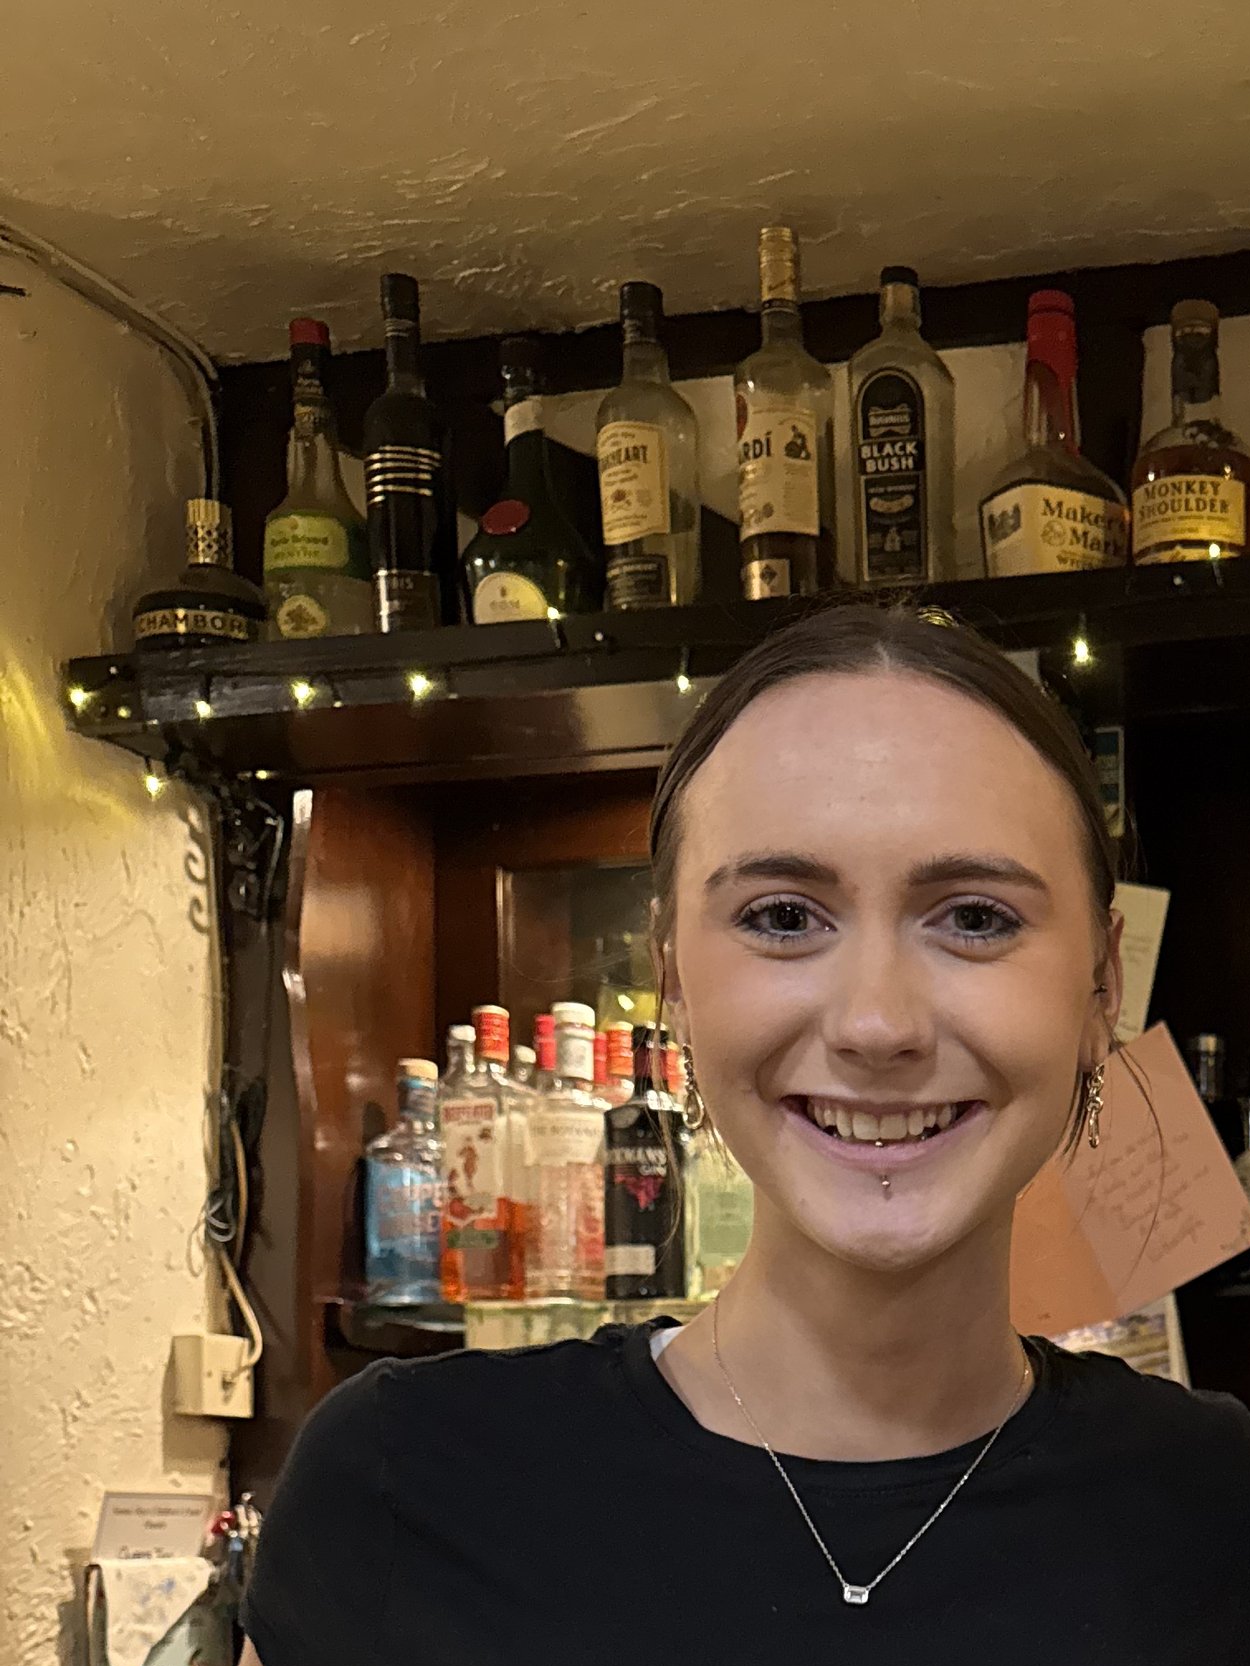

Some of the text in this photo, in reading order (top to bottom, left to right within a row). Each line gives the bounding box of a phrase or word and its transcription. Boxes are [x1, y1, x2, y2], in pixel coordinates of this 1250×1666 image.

[860, 441, 918, 459] BLACK
[865, 456, 914, 473] BUSH
[1143, 480, 1221, 500] MONKEY
[1138, 498, 1230, 520] SHOULDER
